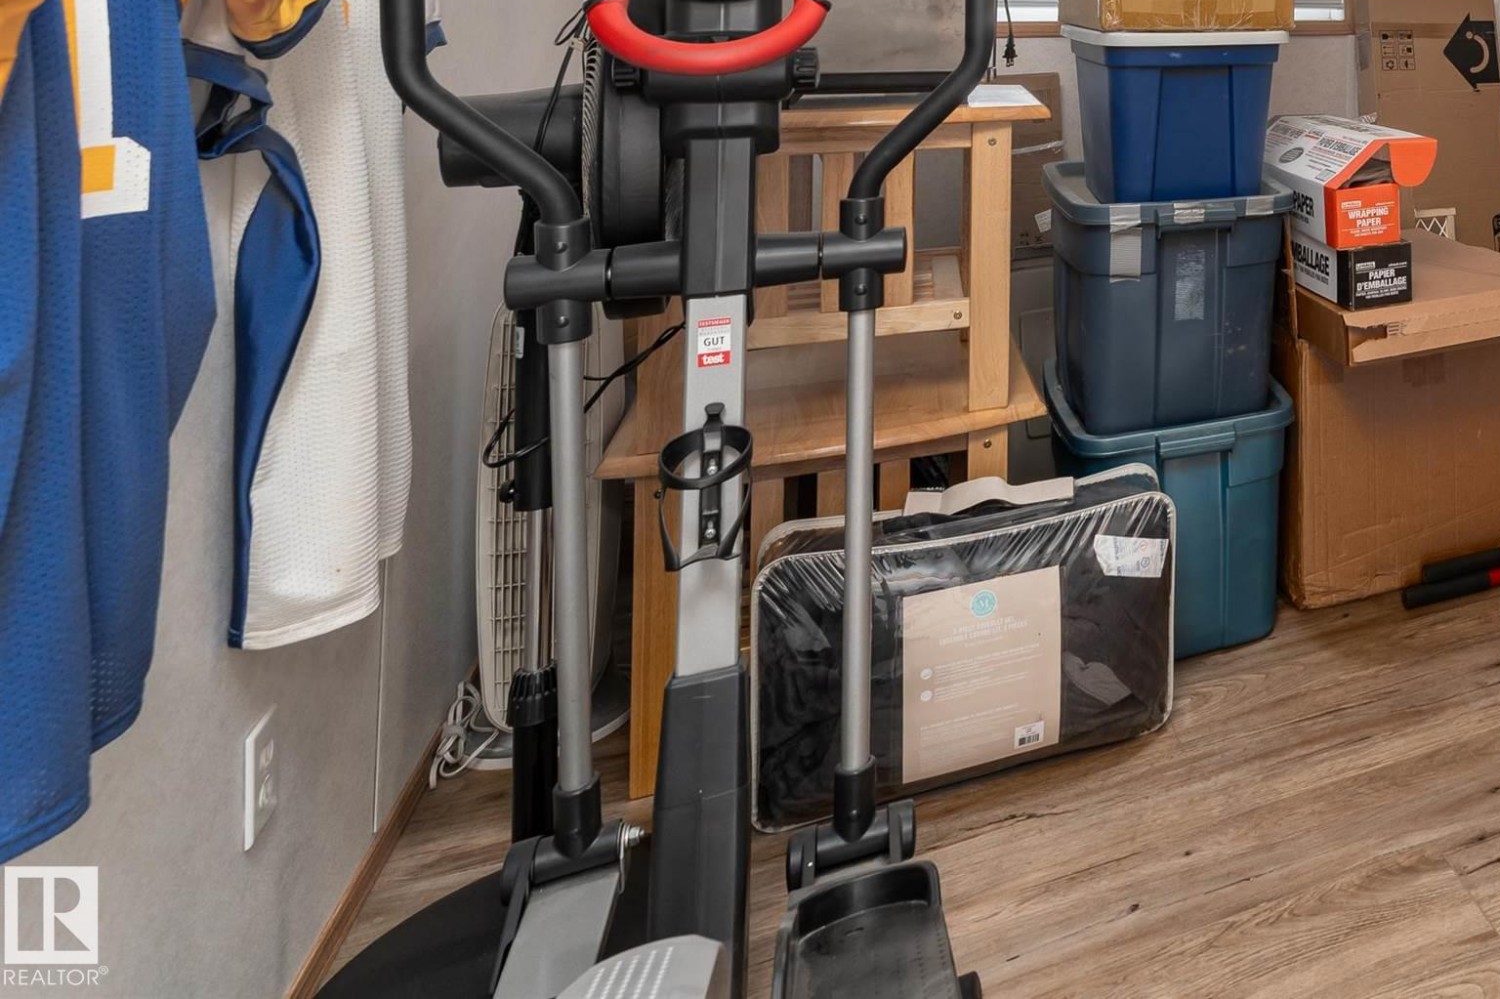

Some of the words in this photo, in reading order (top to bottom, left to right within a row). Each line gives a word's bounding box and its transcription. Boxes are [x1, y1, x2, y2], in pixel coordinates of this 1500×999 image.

[1347, 206, 1389, 220] WRAPPING
[1356, 217, 1382, 228] PAPER
[1368, 269, 1396, 280] PAPIER
[1356, 276, 1407, 291] D'EMBALLAGE
[703, 336, 725, 346] GUT
